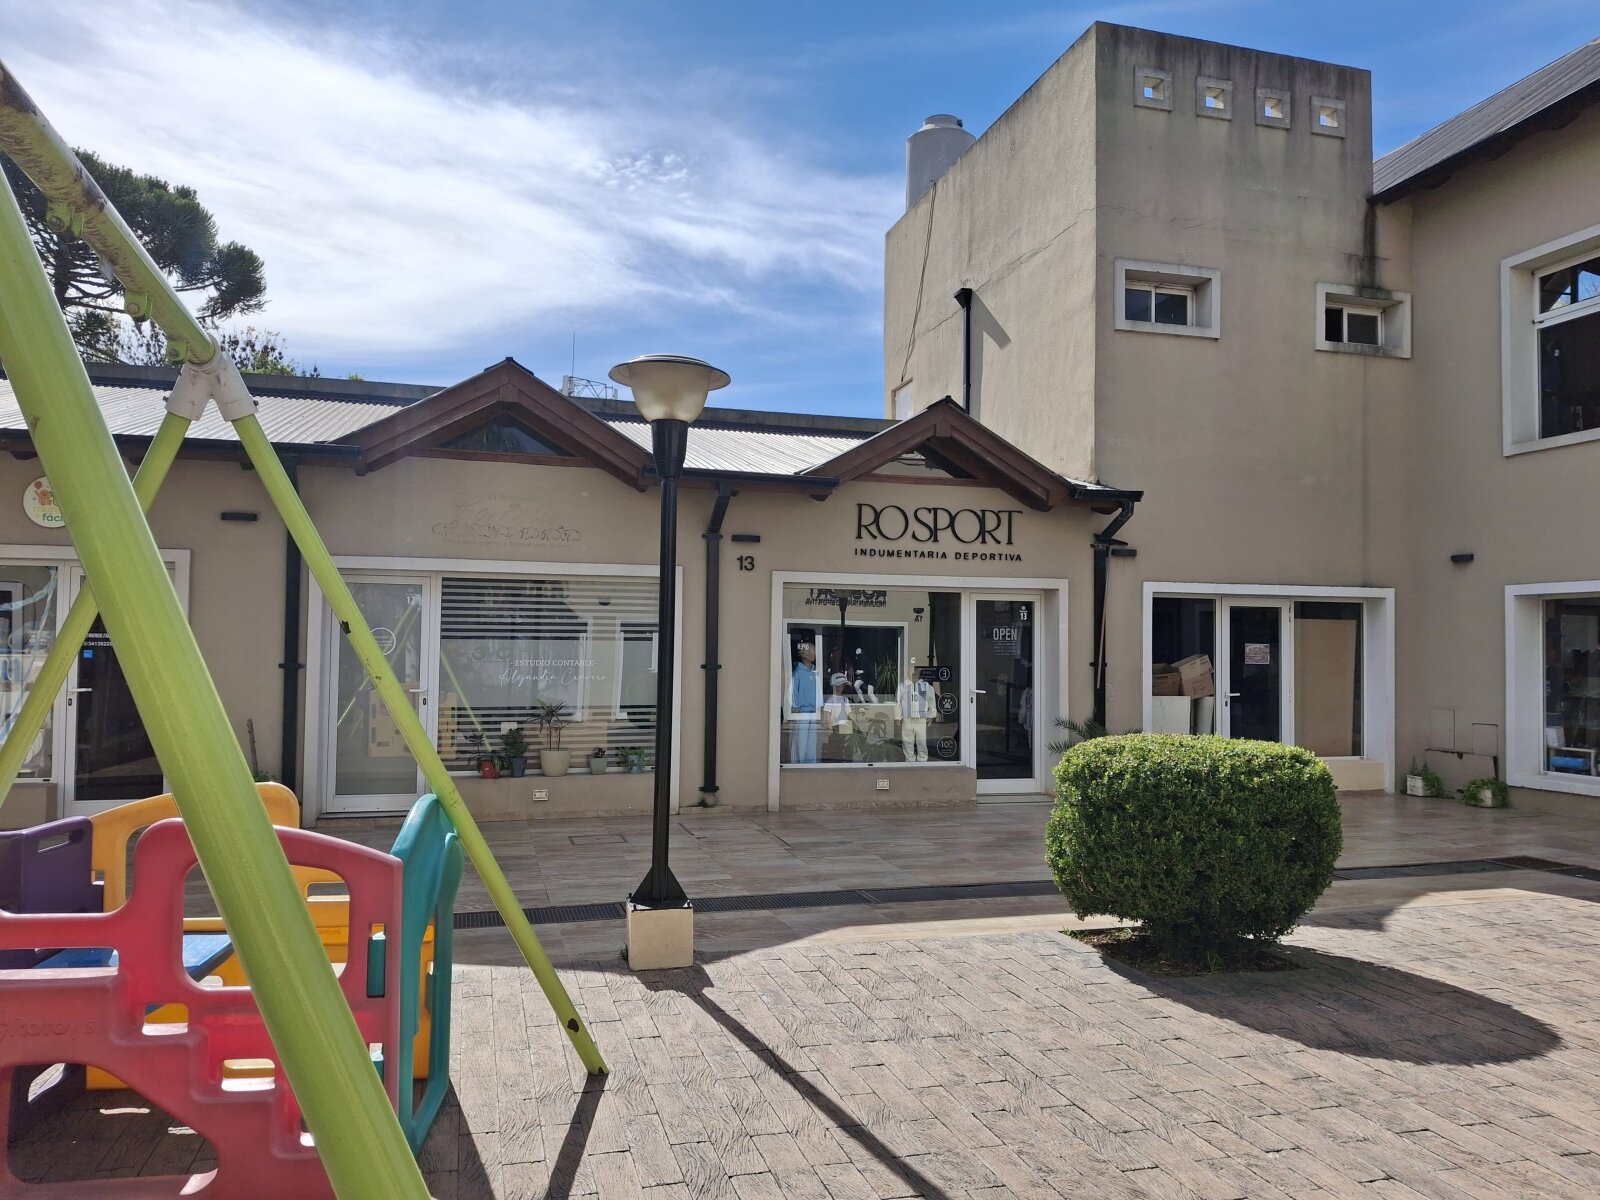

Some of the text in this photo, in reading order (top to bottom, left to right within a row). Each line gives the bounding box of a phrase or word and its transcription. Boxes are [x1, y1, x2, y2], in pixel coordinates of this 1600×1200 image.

[855, 548, 1022, 562] INDUMENTARIA DEPORTIVA
[736, 555, 754, 571] 13
[1020, 612, 1027, 620] 13
[993, 628, 1017, 640] OPEN
